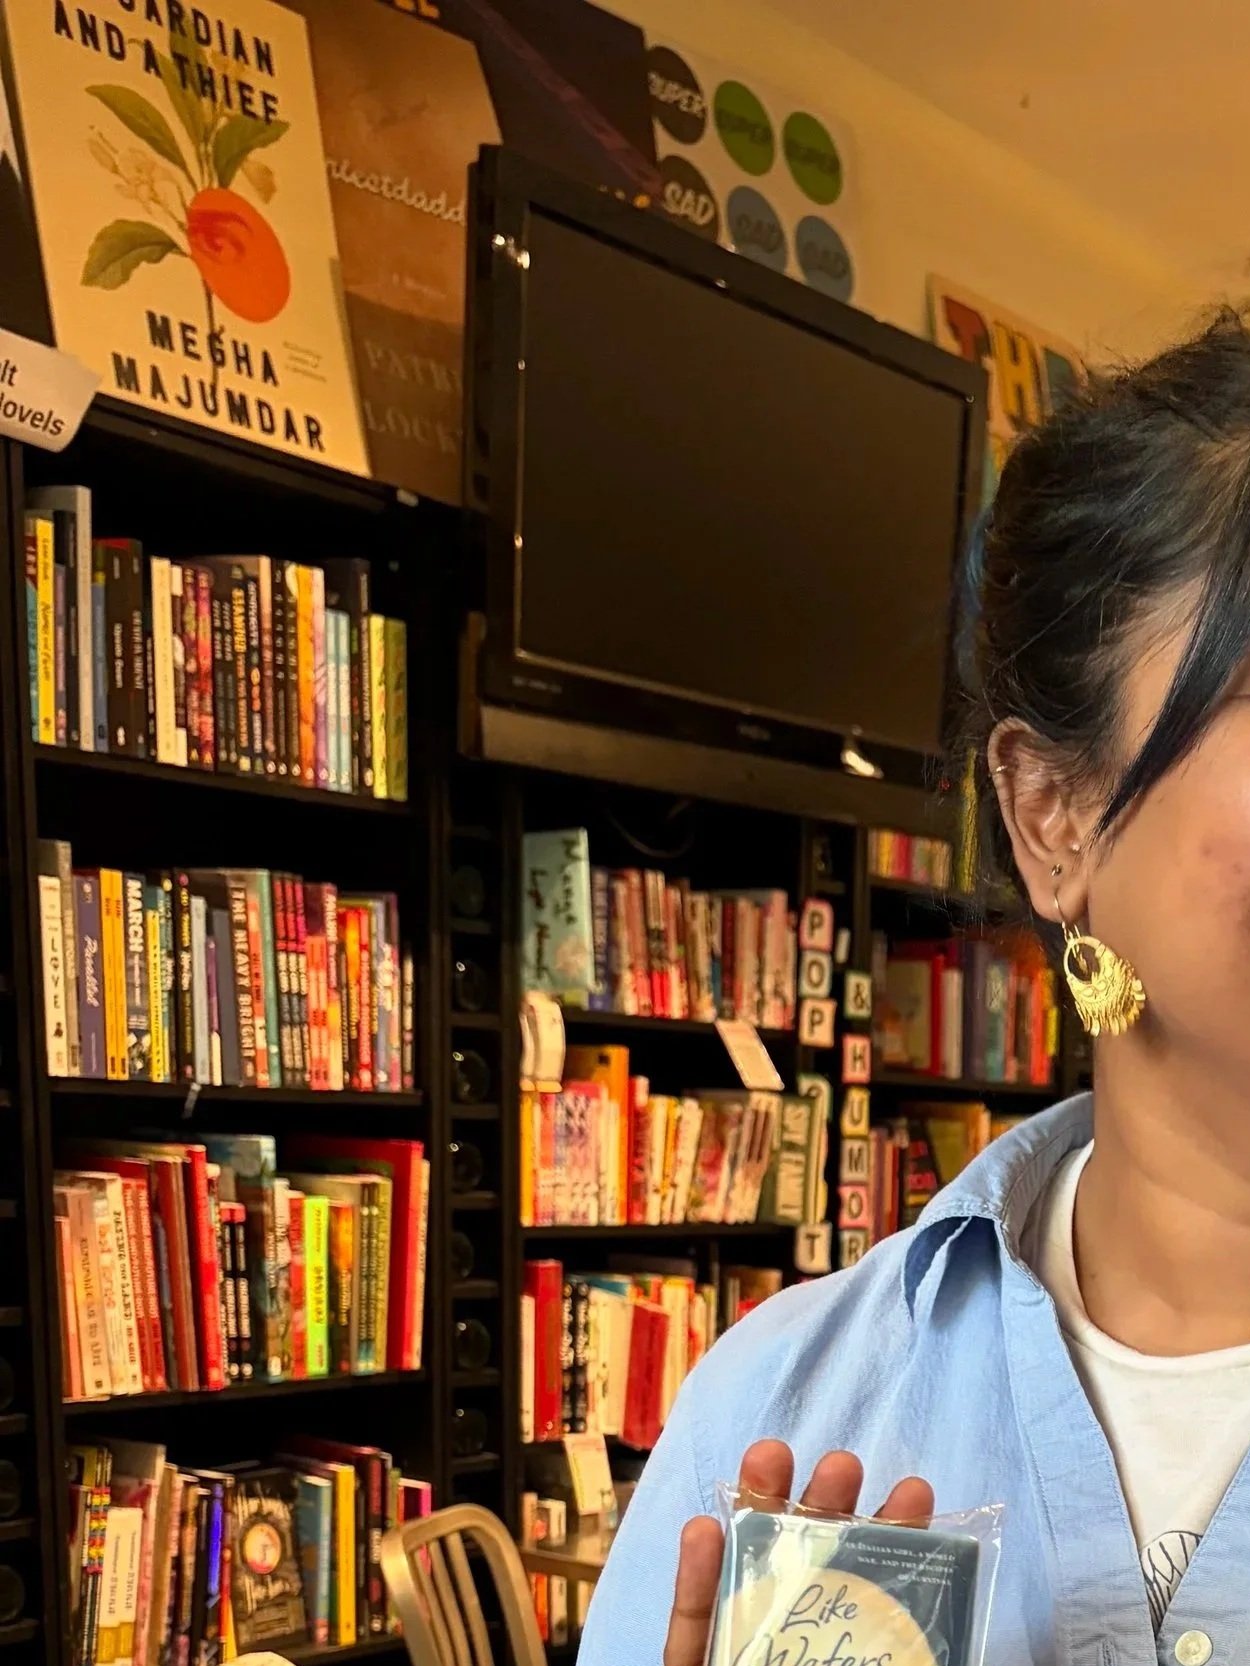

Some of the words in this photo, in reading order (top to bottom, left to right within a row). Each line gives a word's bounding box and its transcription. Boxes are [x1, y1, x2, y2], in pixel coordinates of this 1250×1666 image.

[54, 0, 125, 61] AND
[144, 39, 162, 78] A
[172, 52, 279, 125] THIEF
[664, 180, 716, 226] SAD
[0, 357, 19, 388] lt
[146, 310, 280, 388] MEGHA
[0, 391, 66, 437] ovels
[111, 351, 326, 453] MAJUMDAR
[126, 879, 144, 953] MARCH
[234, 929, 250, 987] HEAVY
[780, 1584, 859, 1634] Like
